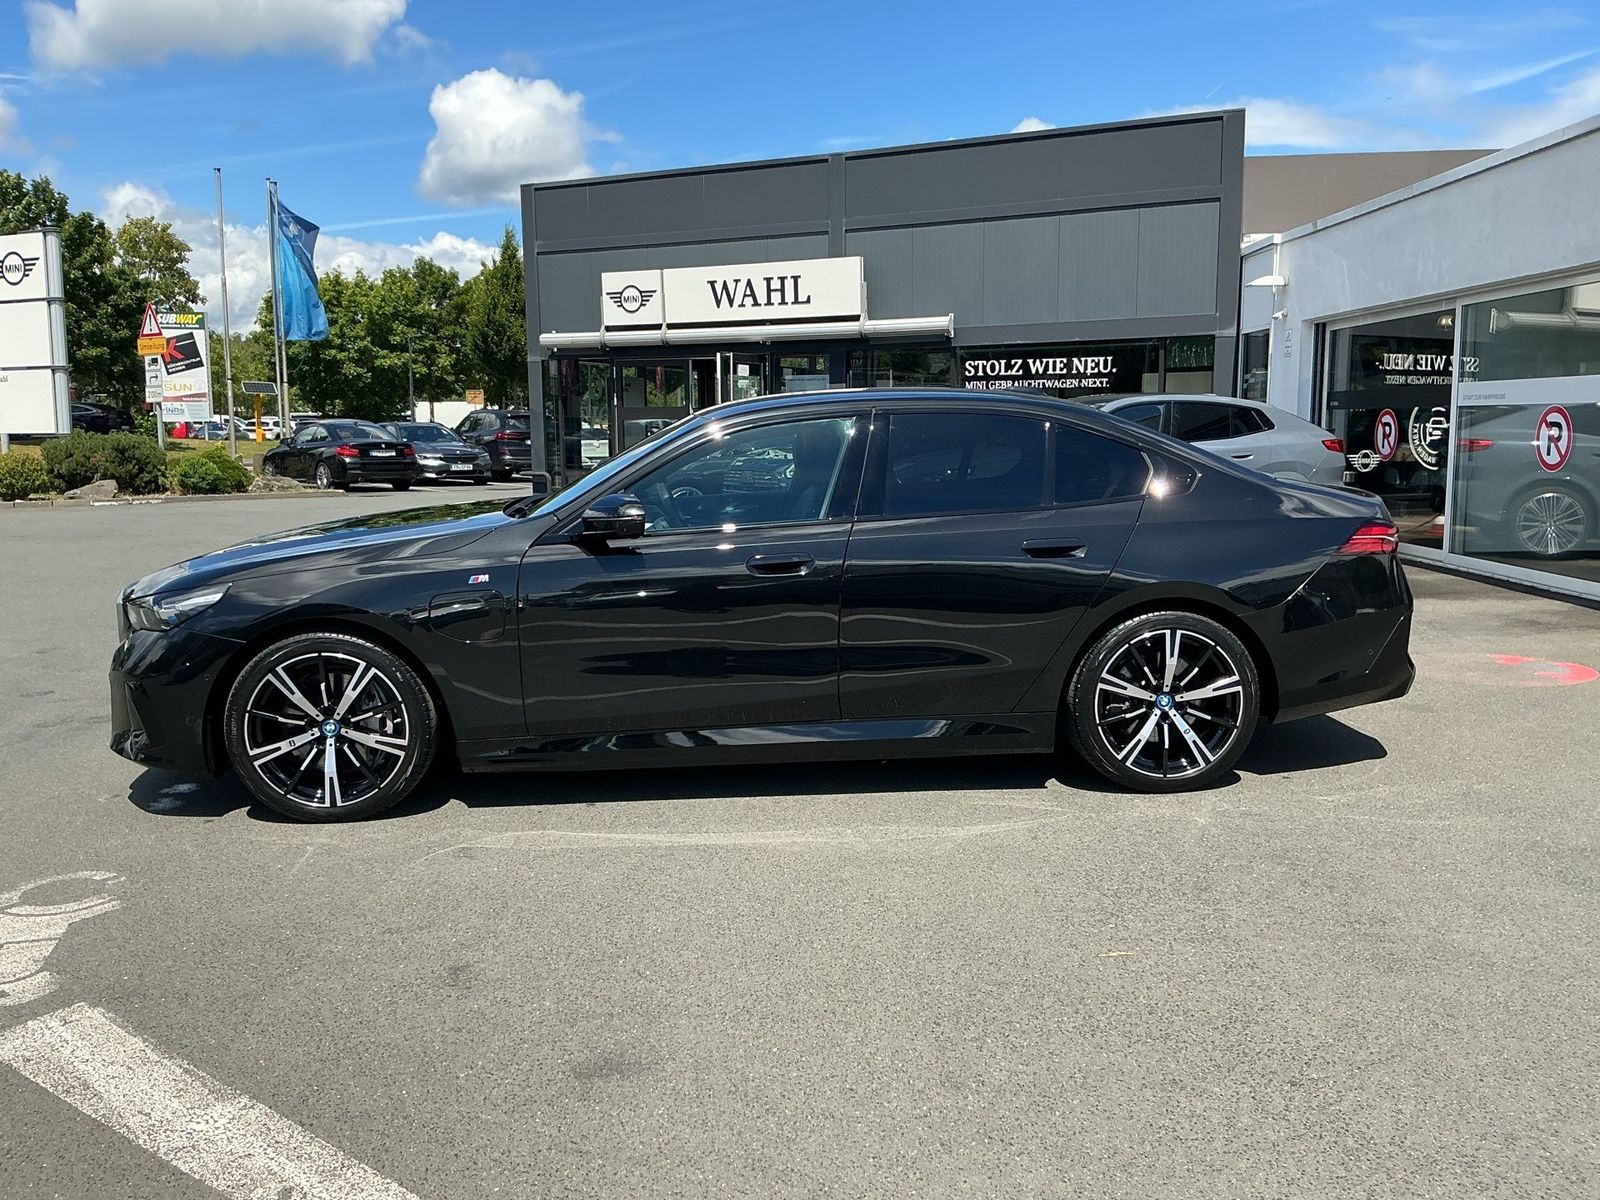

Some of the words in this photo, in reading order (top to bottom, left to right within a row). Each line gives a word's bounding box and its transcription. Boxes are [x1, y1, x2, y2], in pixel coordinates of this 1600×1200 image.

[4, 263, 23, 274] MINI
[706, 275, 811, 309] WAHL
[623, 295, 640, 304] MINI
[157, 313, 203, 325] SUBWAY
[140, 343, 165, 351] Umleitung
[965, 358, 1023, 377] STOLZ
[1027, 357, 1067, 375] WIE
[1071, 356, 1117, 375] NEU.
[164, 384, 193, 392] SUN
[965, 380, 987, 390] MINI
[988, 378, 1079, 390] GEBRAUCHTWAGEN
